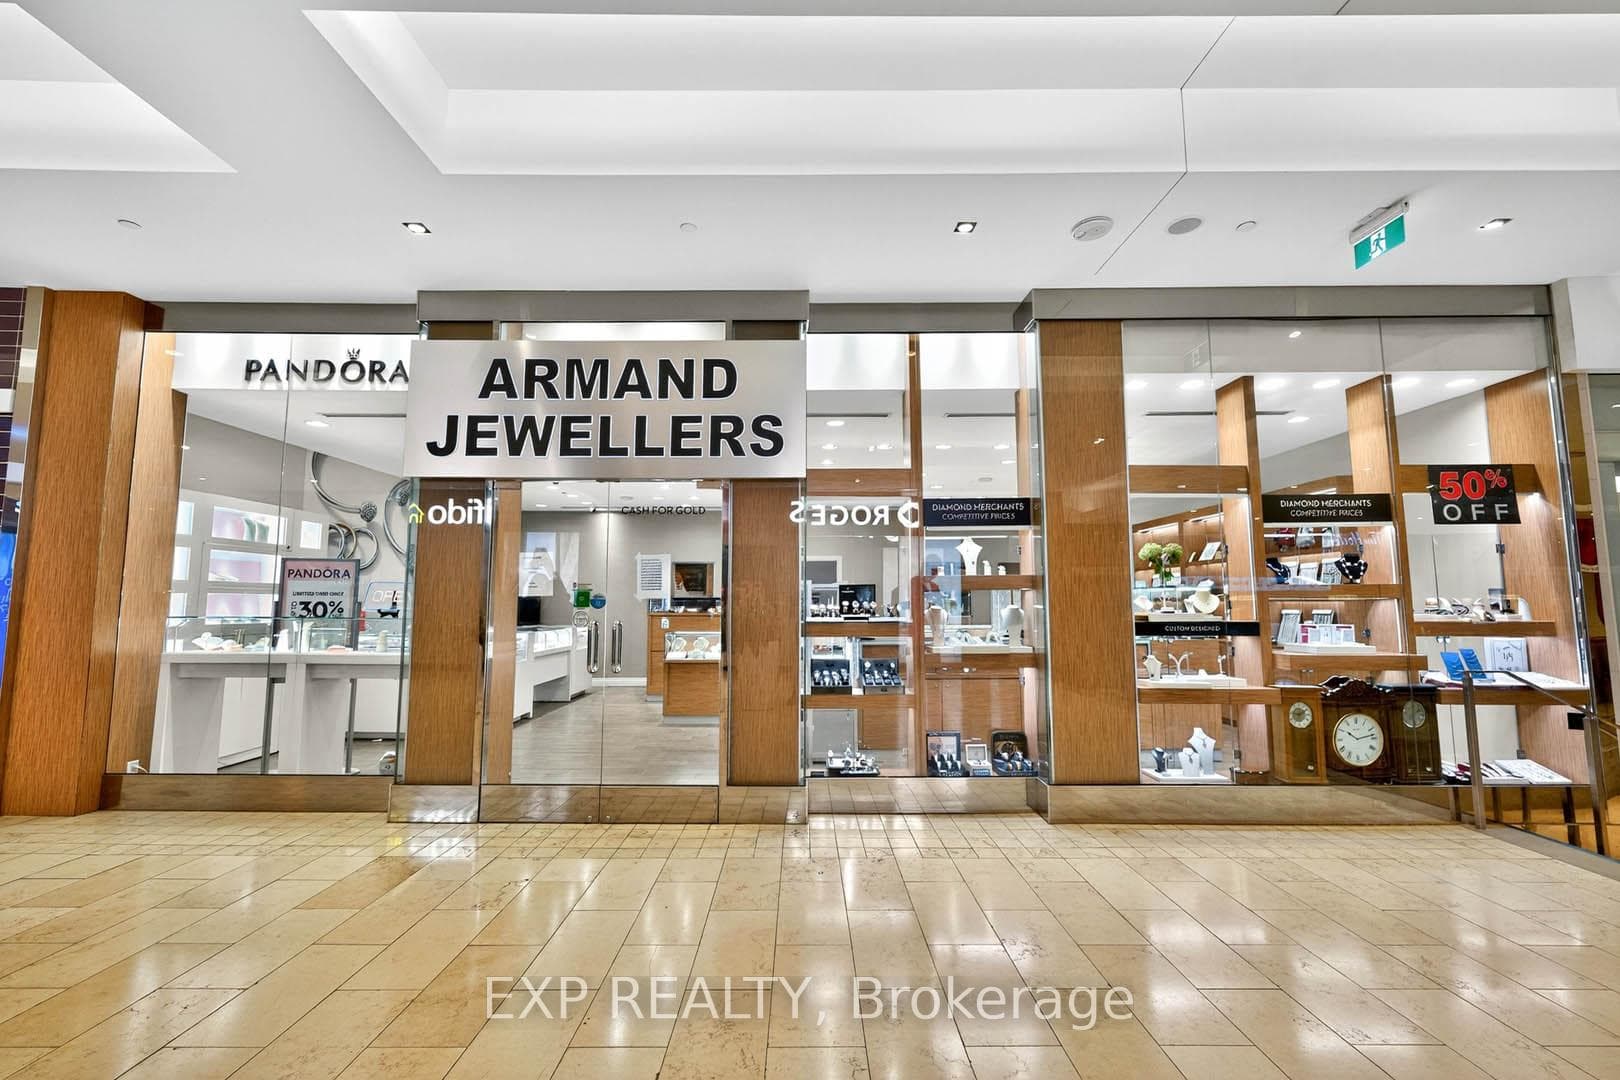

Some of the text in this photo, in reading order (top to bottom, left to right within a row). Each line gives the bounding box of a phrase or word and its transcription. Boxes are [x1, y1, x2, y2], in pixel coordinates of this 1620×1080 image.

[244, 359, 409, 383] PANDORA
[478, 358, 738, 399] ARMAND
[425, 415, 785, 457] JEWELLERS
[1439, 468, 1508, 501] 50%
[621, 505, 706, 515] CASH FOR GOLD
[932, 502, 1025, 511] DIAMOND MERCHANTS
[1280, 499, 1372, 508] DIAMOND MERCHANTS
[1443, 503, 1509, 521] OFF
[287, 568, 351, 579] PANDORA
[299, 601, 344, 618] 30%
